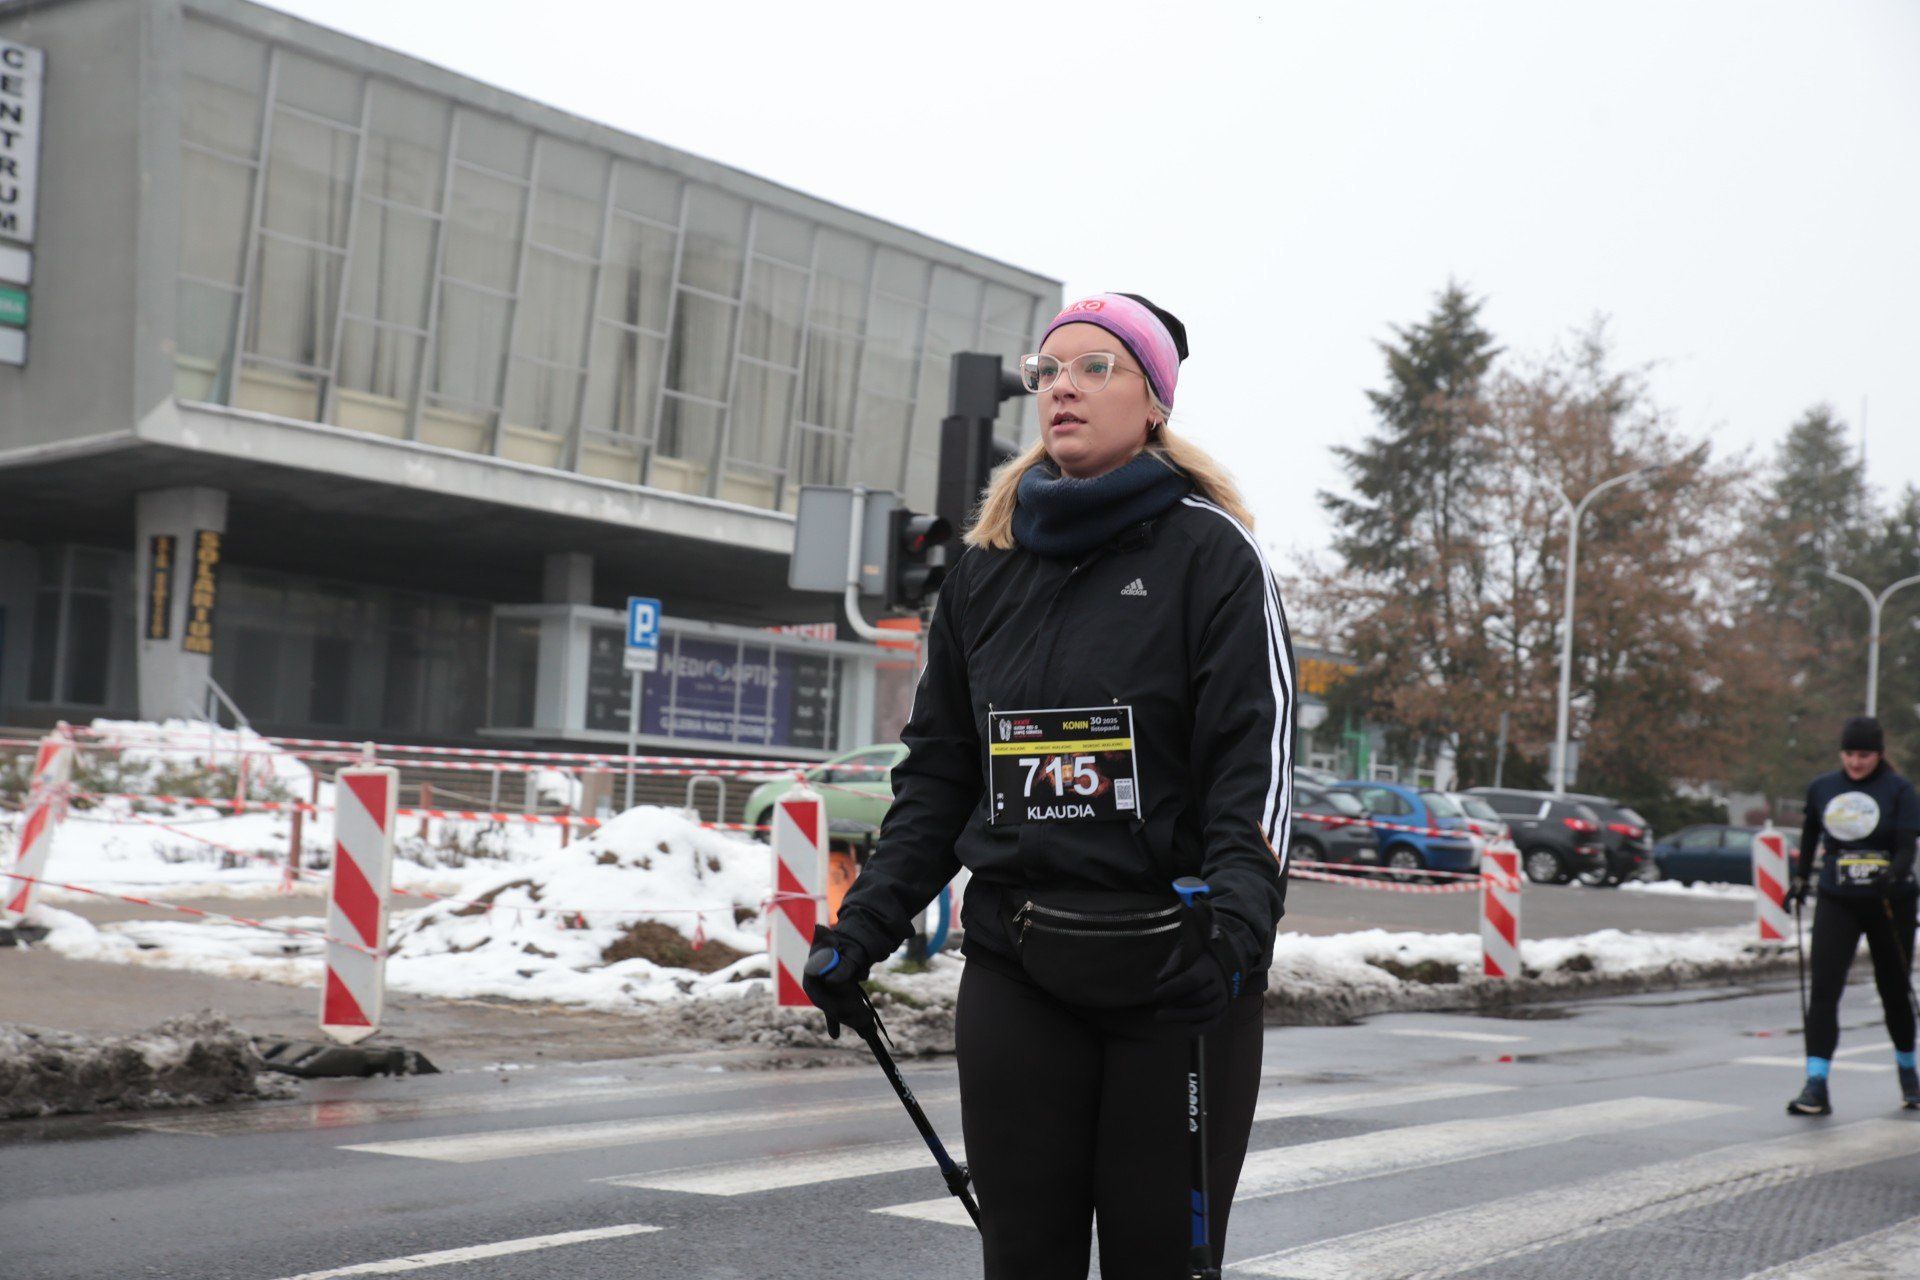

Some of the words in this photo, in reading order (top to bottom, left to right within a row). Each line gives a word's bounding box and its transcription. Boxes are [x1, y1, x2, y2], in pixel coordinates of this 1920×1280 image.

[0, 46, 25, 234] CENTRUM
[1120, 588, 1147, 597] adidas
[634, 604, 655, 643] P
[1062, 721, 1089, 731] KONIN
[1090, 717, 1102, 725] 30
[1090, 725, 1120, 733] listopada
[1018, 755, 1099, 798] 715
[1027, 804, 1096, 820] KLAUDIA
